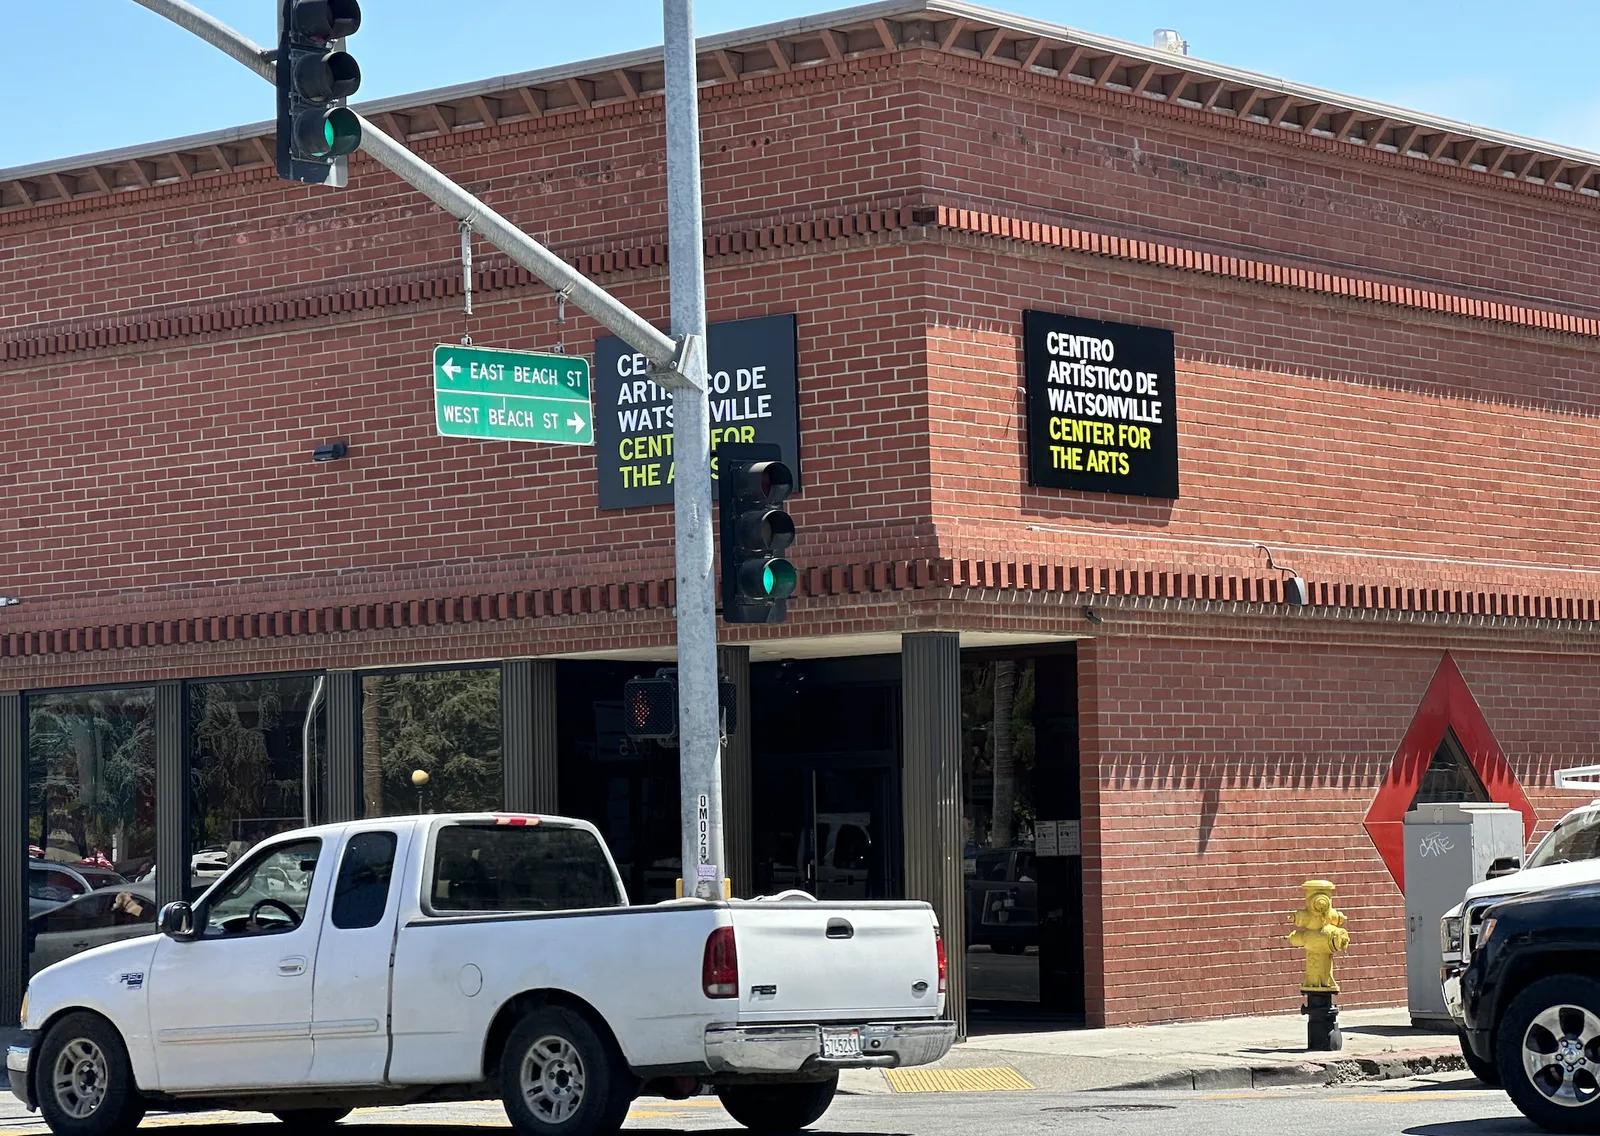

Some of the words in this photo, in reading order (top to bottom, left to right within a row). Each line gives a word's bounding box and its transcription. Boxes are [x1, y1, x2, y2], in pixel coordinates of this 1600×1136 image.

[1047, 331, 1114, 362] CENTRO
[470, 362, 504, 381] EAST
[514, 366, 558, 385] BEACH
[567, 371, 582, 387] ST
[736, 366, 767, 392] DE
[1047, 359, 1132, 392] ARTÍSTICO
[1136, 372, 1158, 396] DE
[443, 405, 479, 424] WEST
[489, 408, 534, 428] BEACH
[543, 412, 558, 430] ST
[617, 394, 772, 432] WATSVILLE
[1047, 388, 1162, 423] WATSONVILLE
[619, 434, 674, 461] CENT
[711, 426, 755, 450] FOR
[1049, 416, 1115, 445] CENTER
[1118, 424, 1151, 449] FOR
[619, 463, 661, 488] THE
[1049, 445, 1083, 471] THE
[1086, 449, 1130, 475] ARTS
